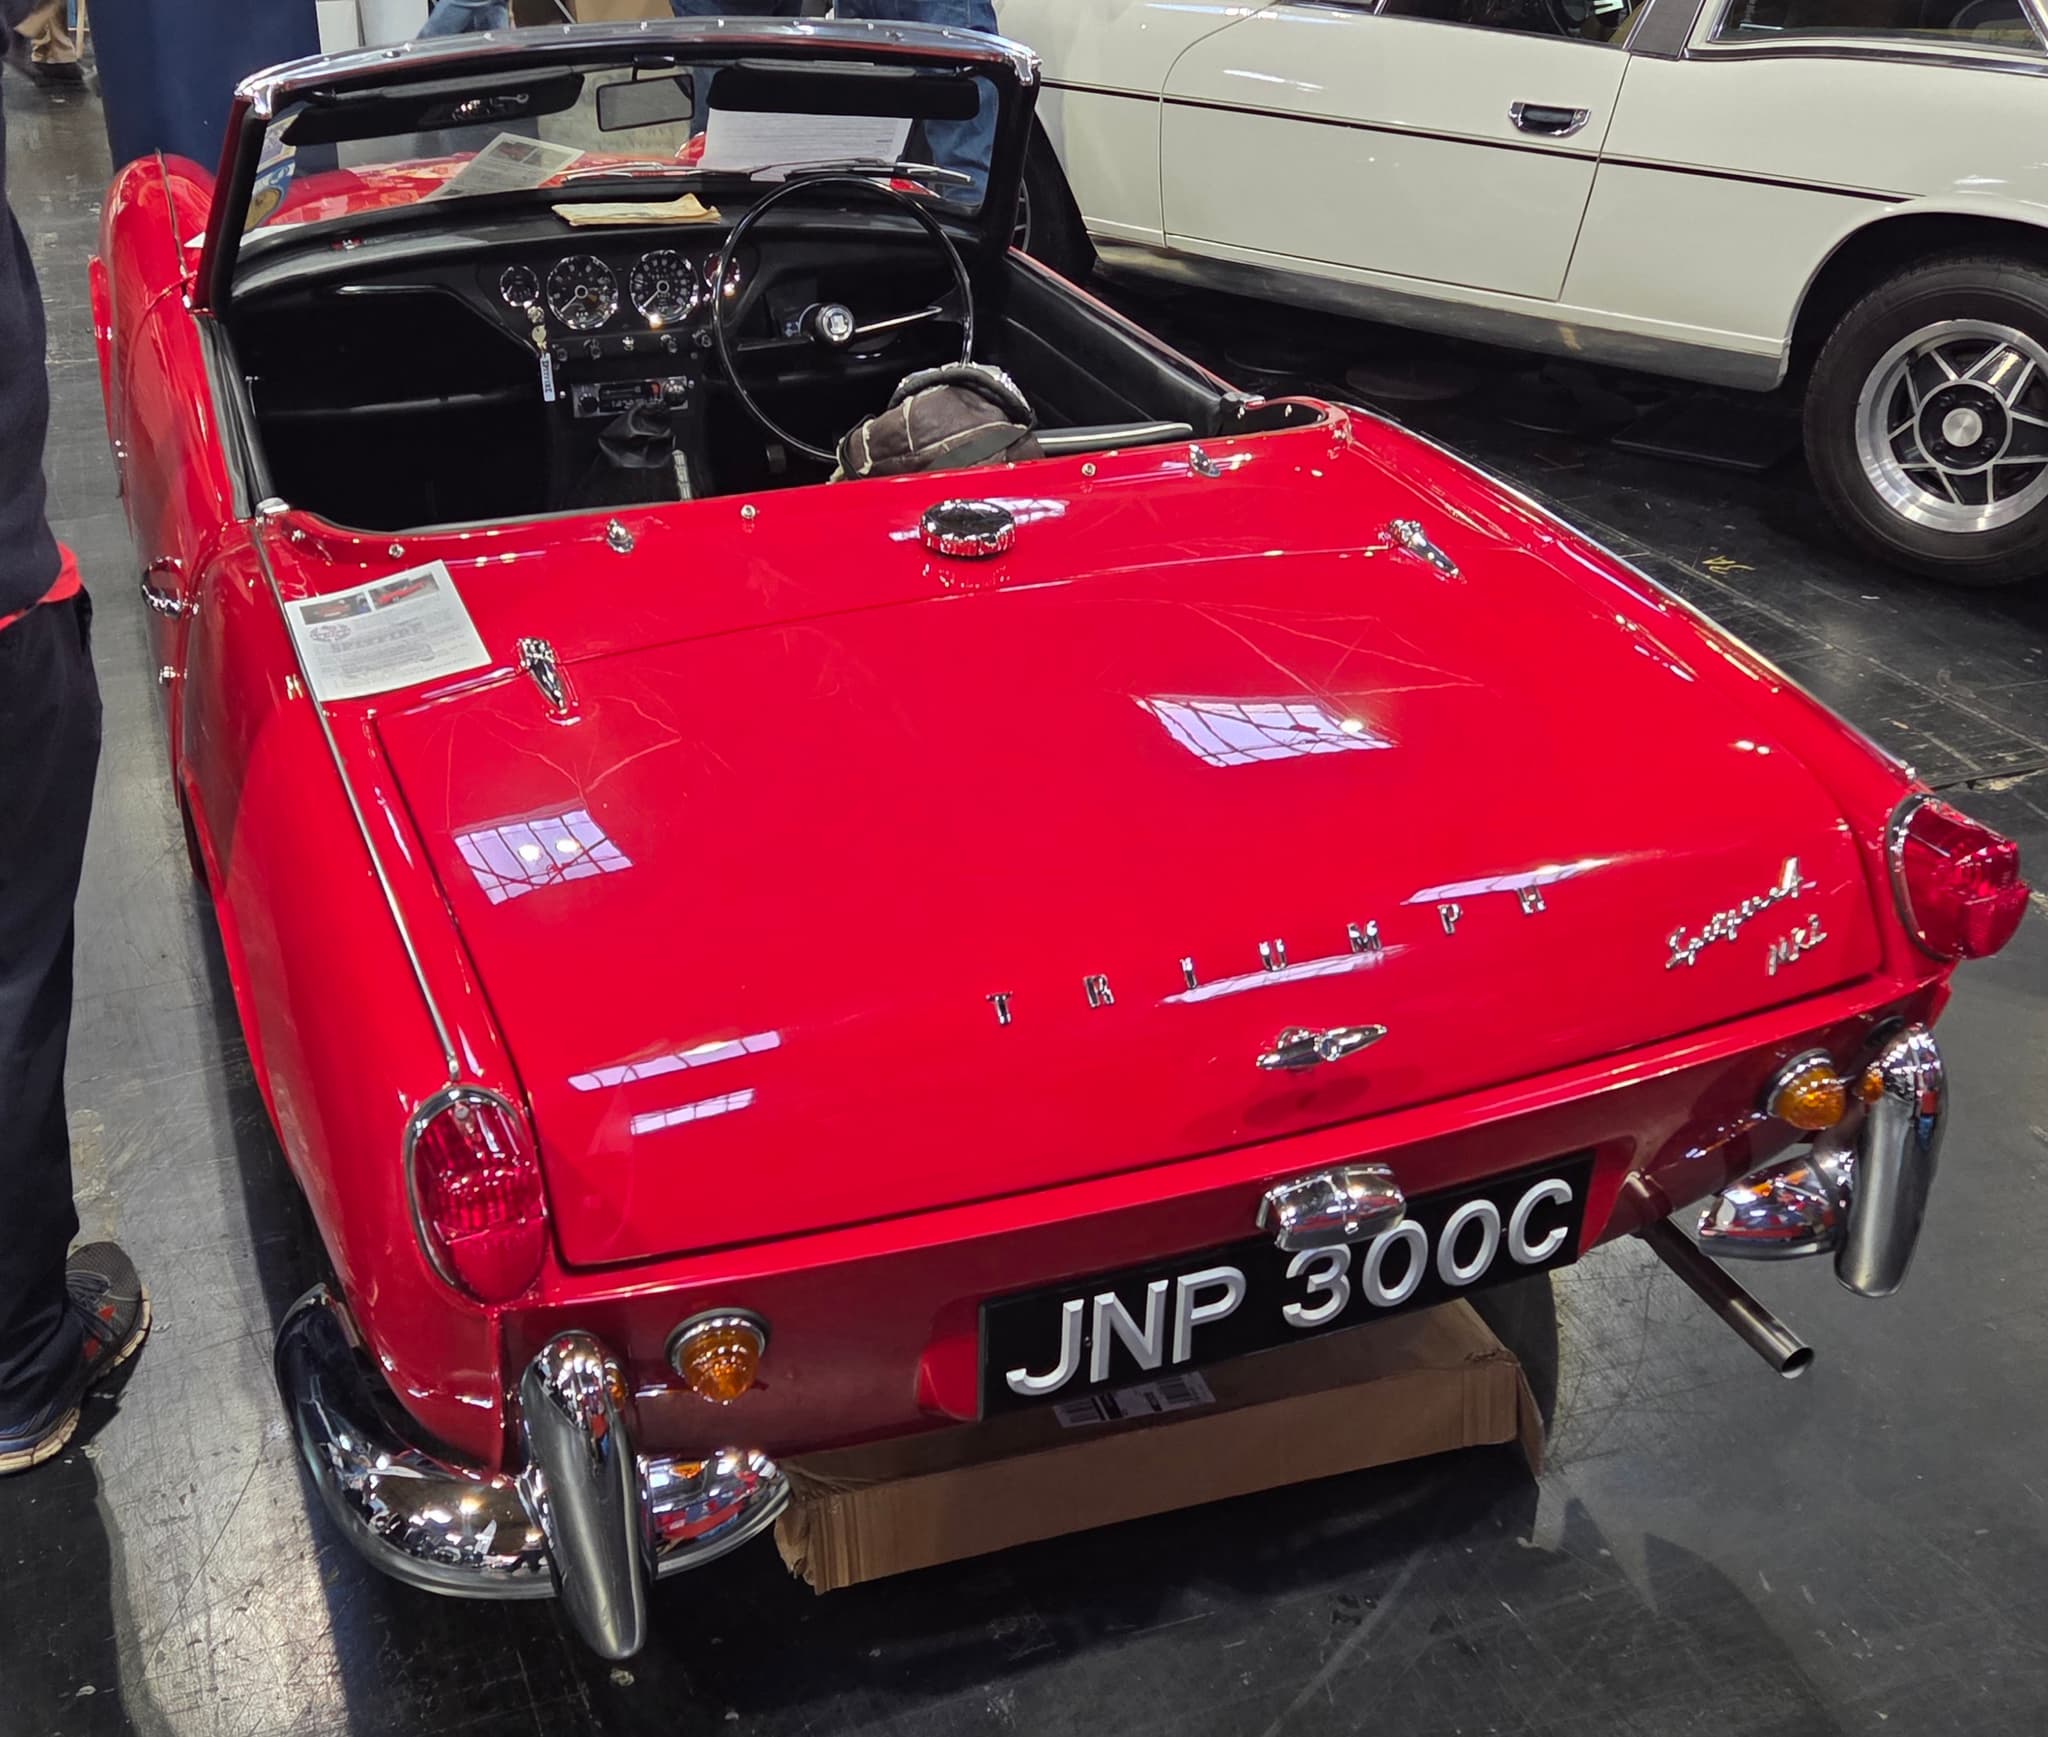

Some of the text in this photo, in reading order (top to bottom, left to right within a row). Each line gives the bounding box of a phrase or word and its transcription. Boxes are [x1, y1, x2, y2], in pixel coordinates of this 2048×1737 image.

[986, 884, 1547, 1025] TRIUMPH
[1006, 1178, 1574, 1397] JNP 300C
